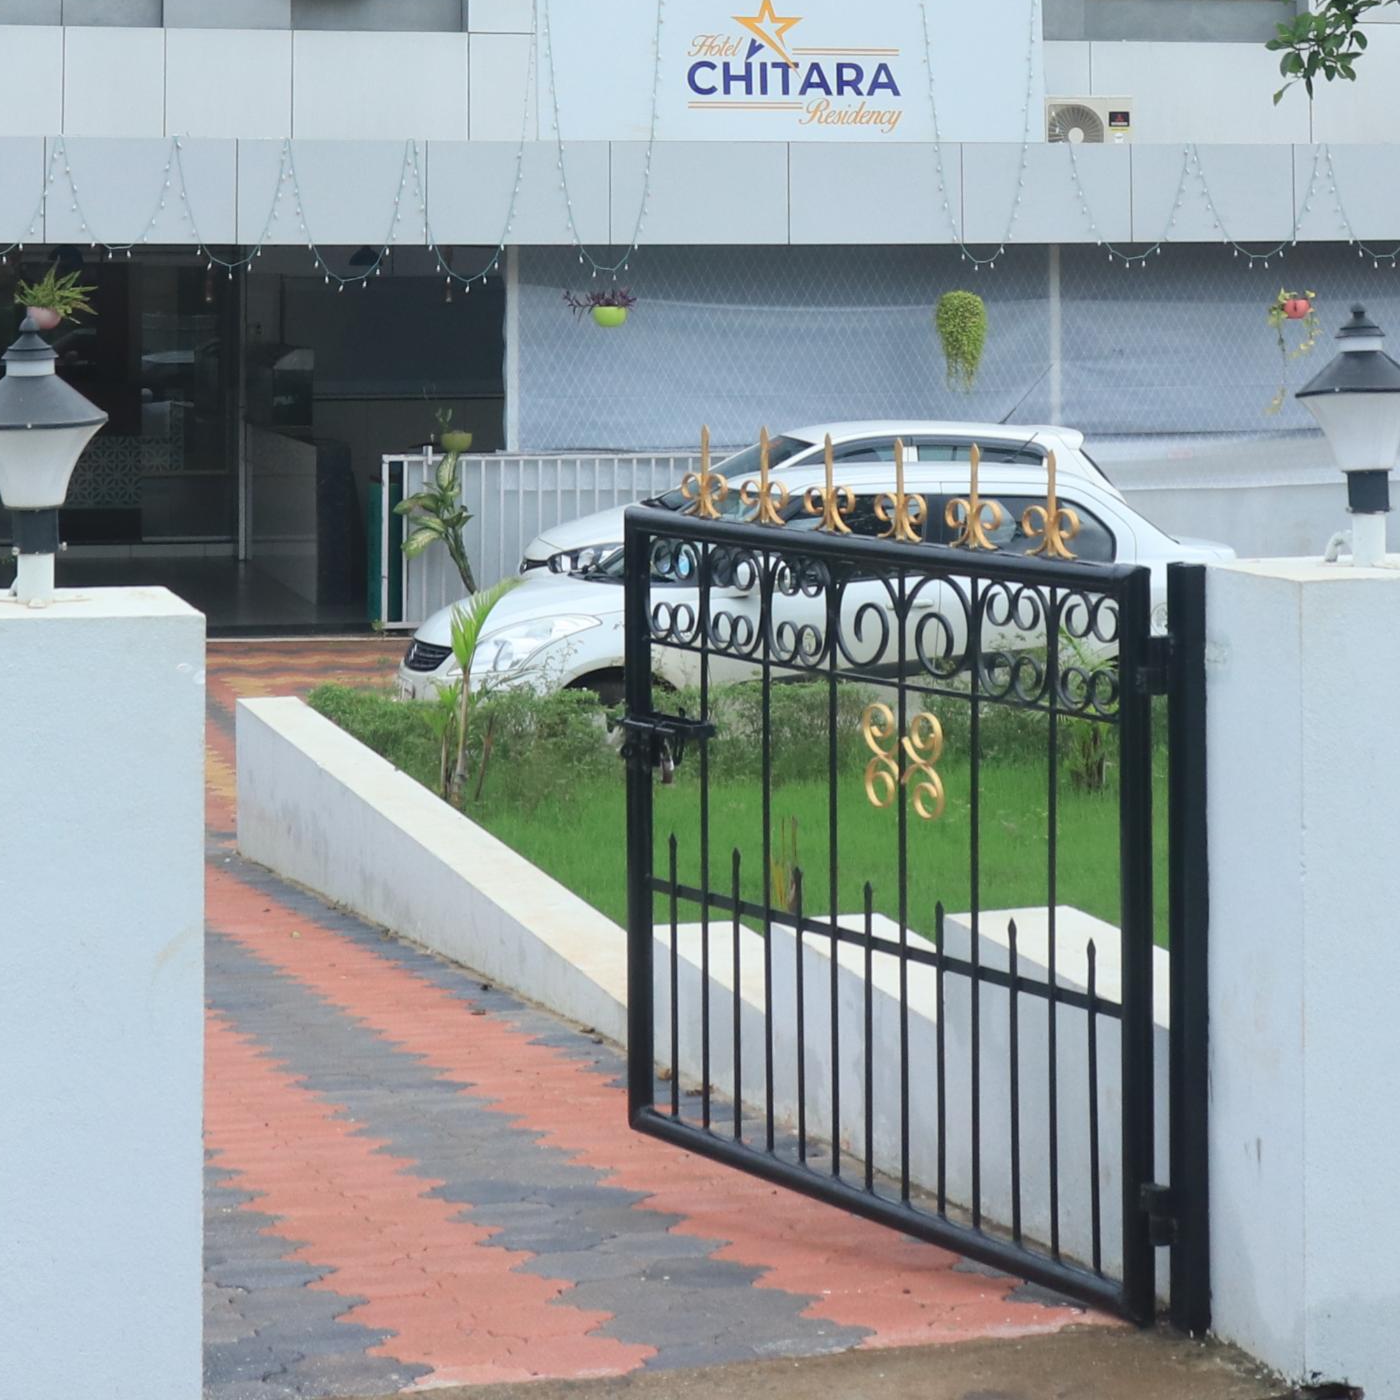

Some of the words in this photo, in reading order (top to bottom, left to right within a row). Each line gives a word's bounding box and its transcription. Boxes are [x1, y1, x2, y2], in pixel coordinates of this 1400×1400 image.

[687, 34, 744, 57] Hotel
[687, 60, 902, 96] CHITARA
[798, 98, 903, 134] Residency
